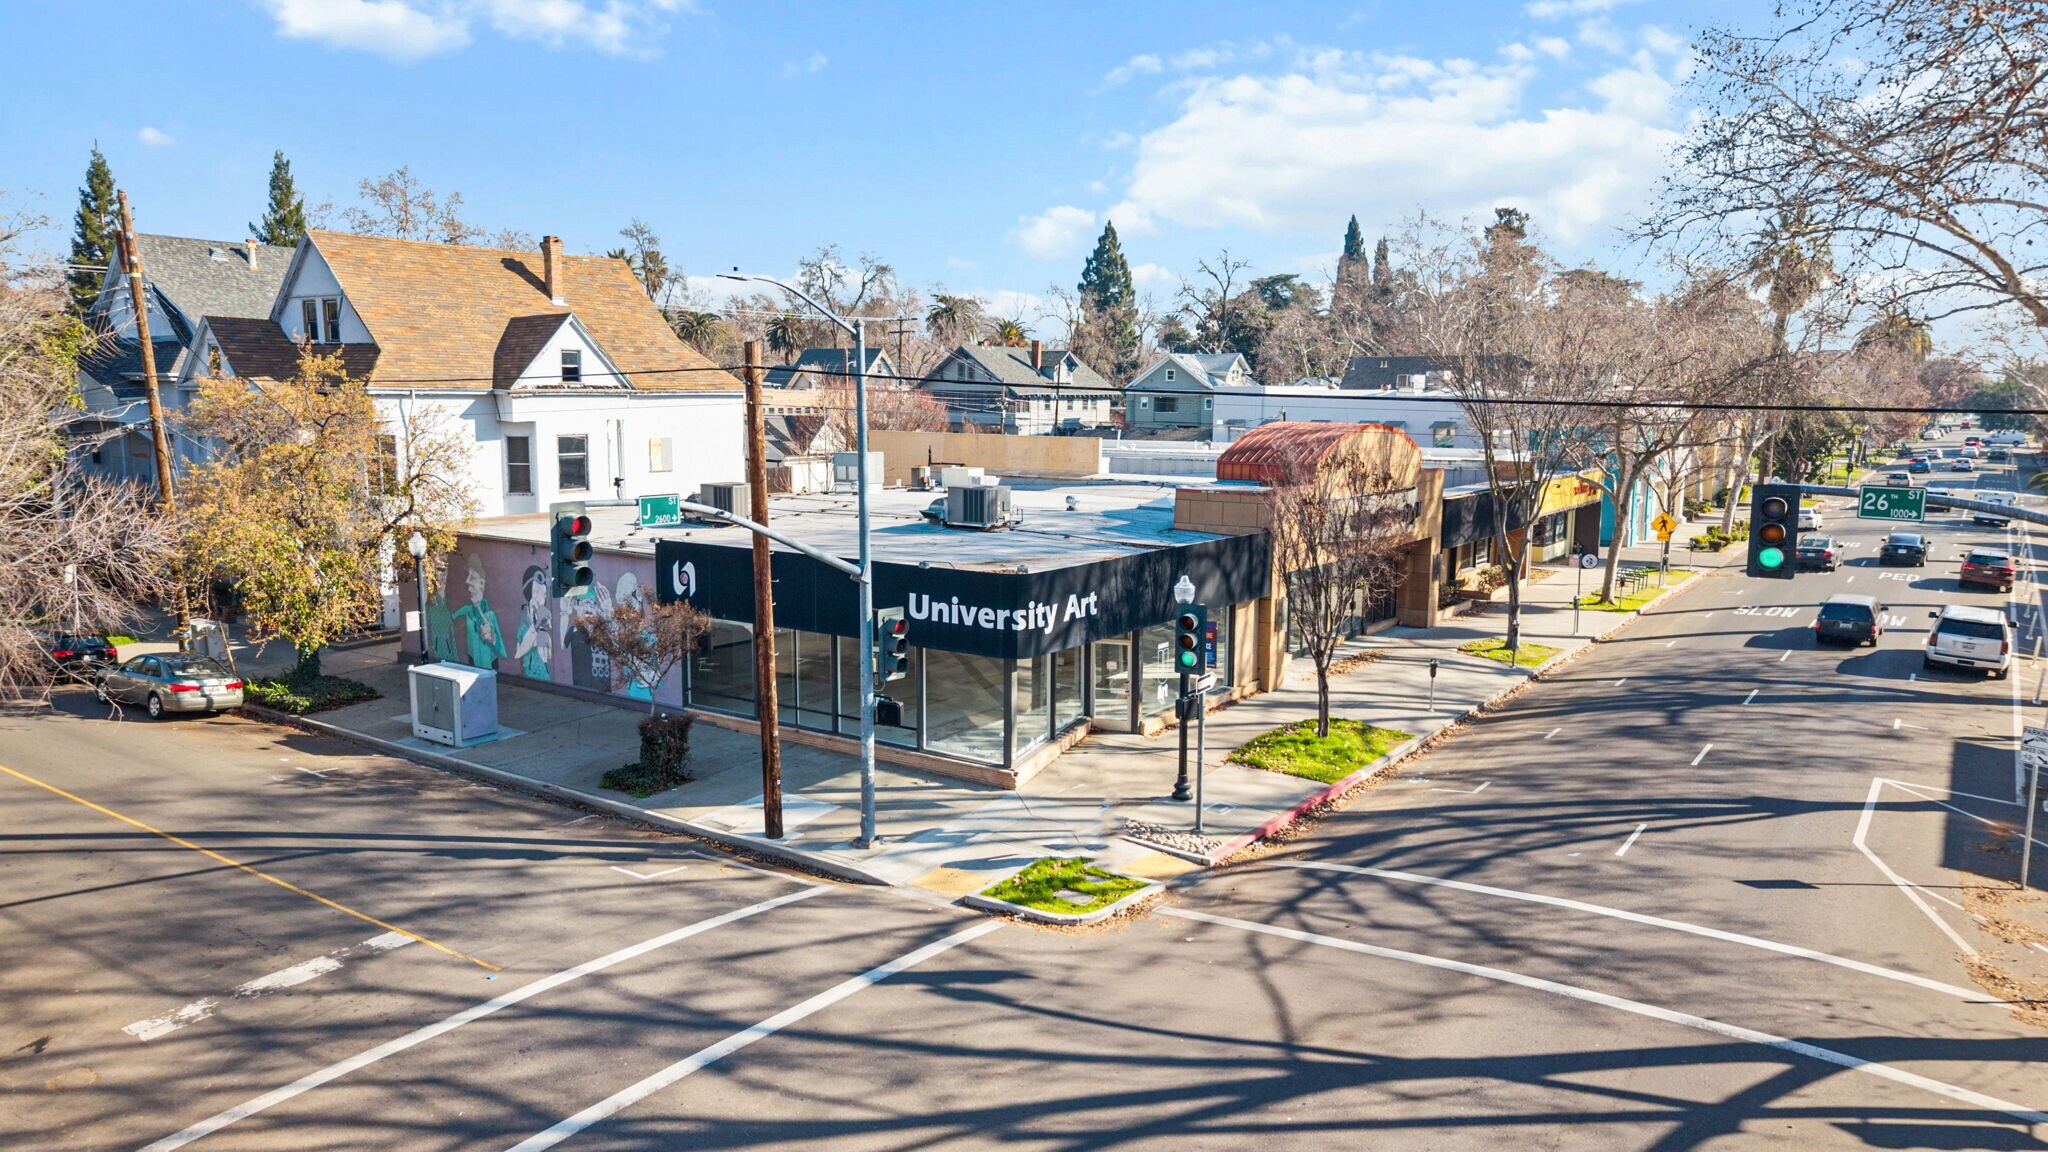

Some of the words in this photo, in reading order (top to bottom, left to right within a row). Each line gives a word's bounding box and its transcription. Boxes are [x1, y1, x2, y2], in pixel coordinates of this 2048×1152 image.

[1863, 492, 1889, 510] 26
[1907, 490, 1922, 500] ST
[642, 503, 651, 520] J
[667, 497, 677, 505] ST
[1890, 508, 1909, 518] 1000
[655, 514, 671, 524] 2600
[1878, 571, 1921, 581] PED
[908, 592, 1058, 635] University
[1063, 590, 1098, 622] Art
[1733, 605, 1800, 618] SLOW
[2023, 727, 2048, 737] PARKIN
